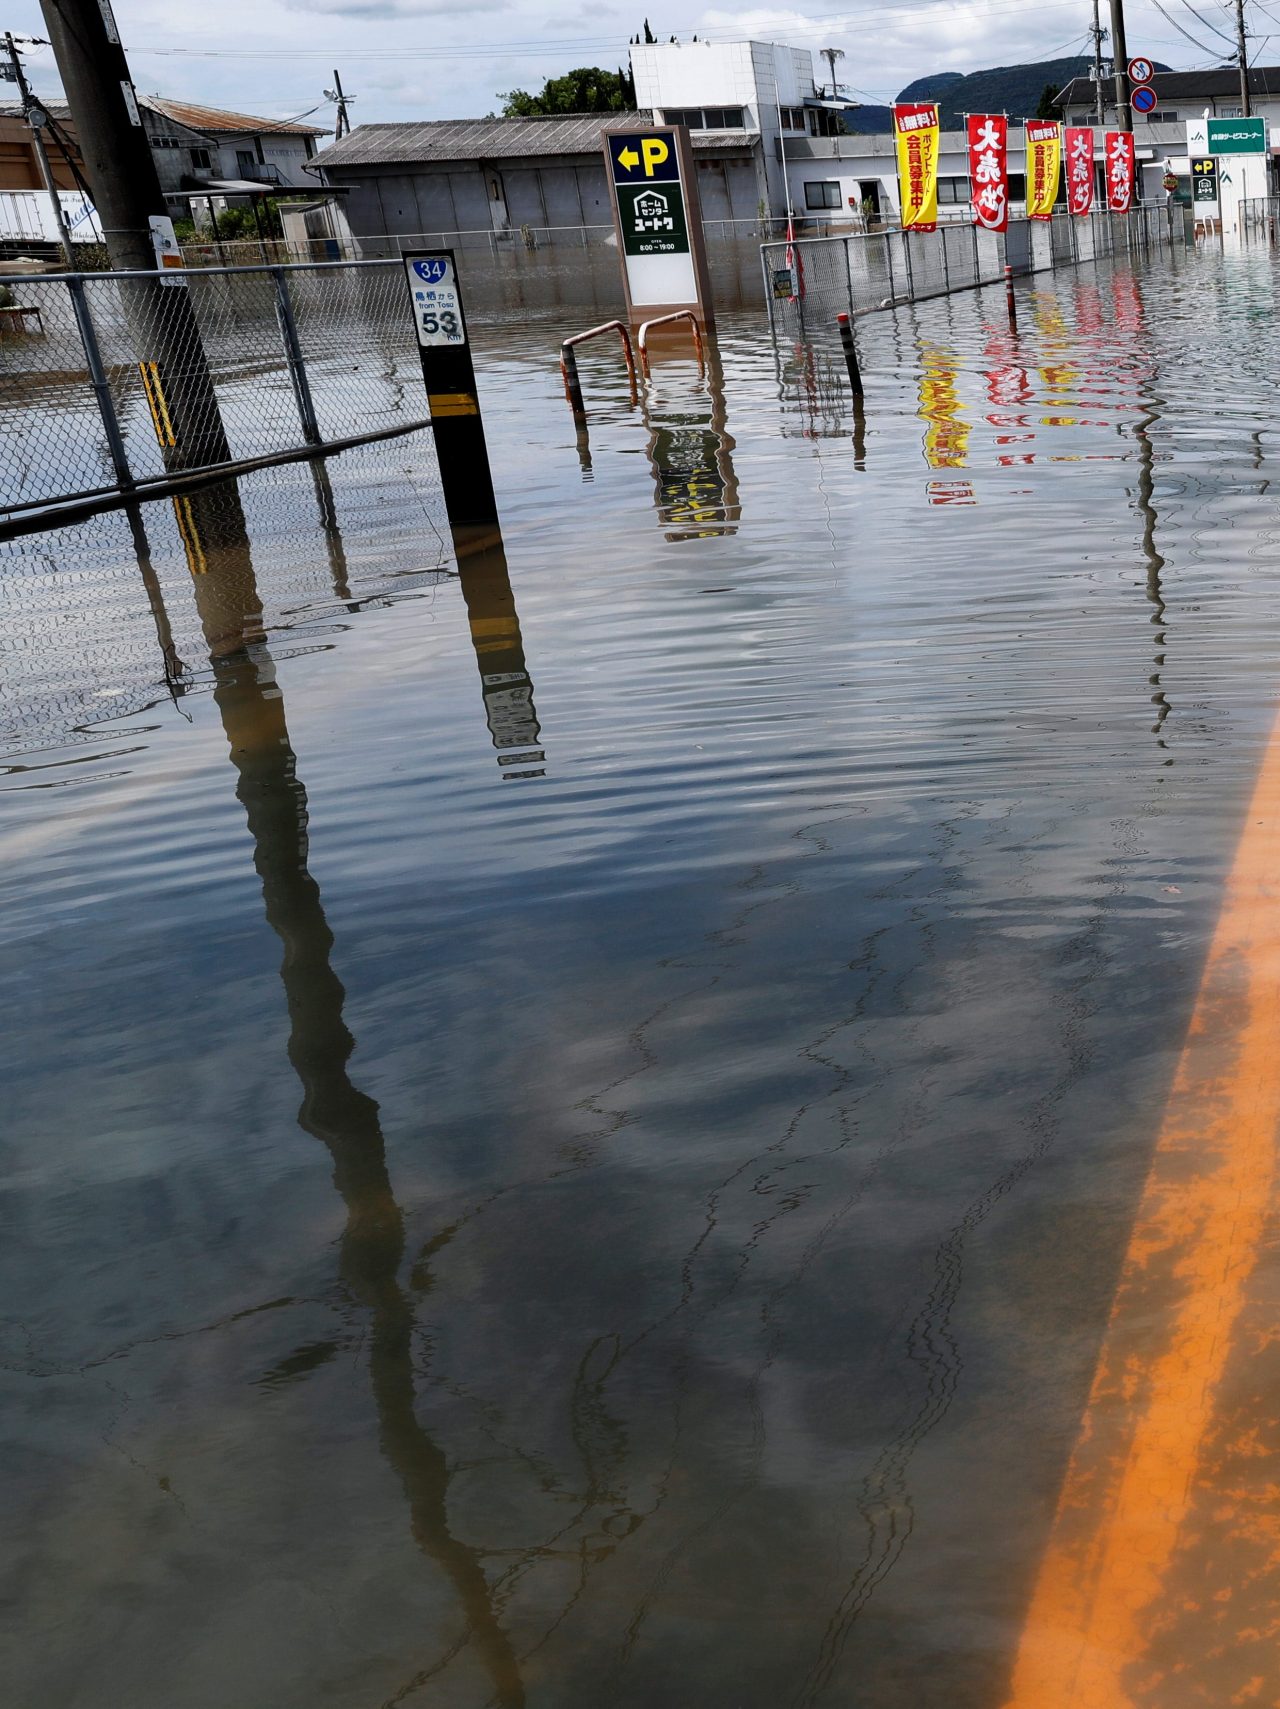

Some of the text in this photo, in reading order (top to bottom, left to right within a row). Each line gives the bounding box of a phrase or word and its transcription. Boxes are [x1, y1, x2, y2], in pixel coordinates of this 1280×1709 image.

[641, 138, 669, 177] P
[1203, 160, 1213, 175] P
[640, 200, 661, 208] ホーム
[642, 208, 669, 216] センター
[634, 217, 674, 232] ユートク
[421, 262, 442, 279] 34
[423, 311, 457, 334] 53
